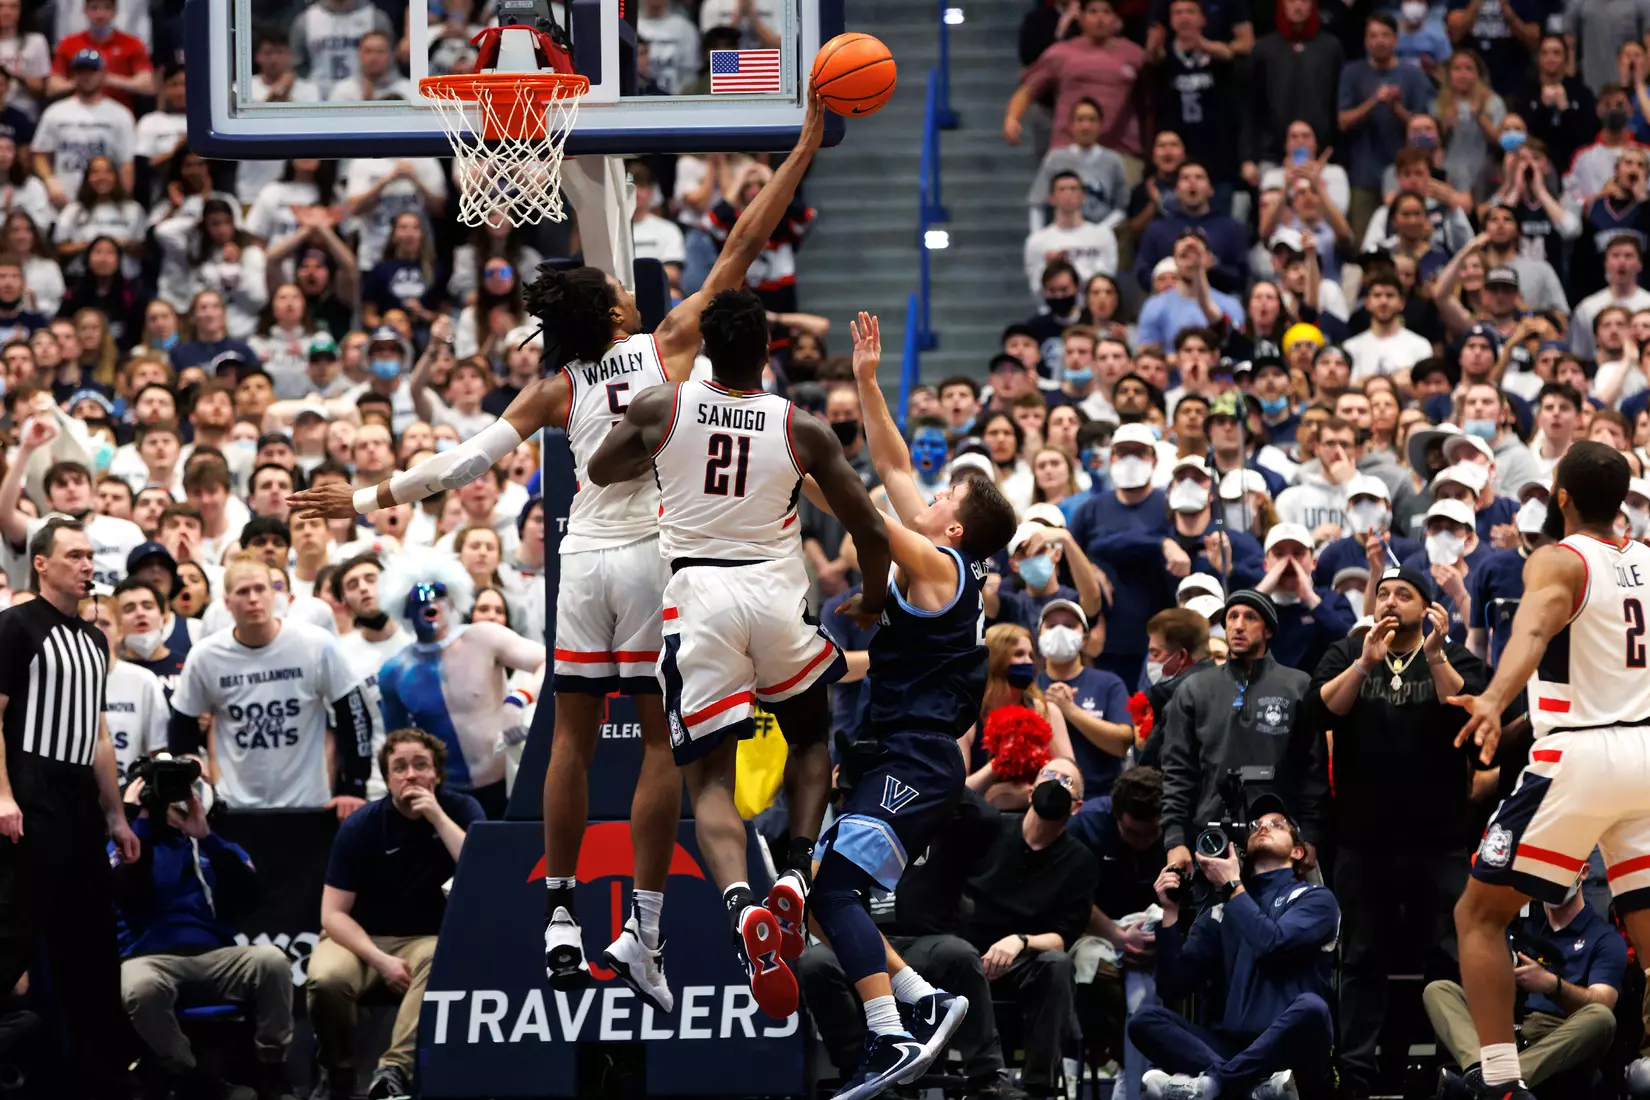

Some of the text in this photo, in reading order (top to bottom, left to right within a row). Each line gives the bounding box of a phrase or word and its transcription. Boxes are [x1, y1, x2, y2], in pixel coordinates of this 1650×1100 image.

[583, 352, 643, 386] WHALEY
[697, 403, 766, 432] SANOGO
[704, 433, 750, 498] 21
[1623, 597, 1647, 668] 2
[219, 667, 304, 688] BEAT VILLANOVA
[228, 698, 300, 722] DOGS
[235, 728, 299, 749] CATS
[880, 774, 919, 814] V
